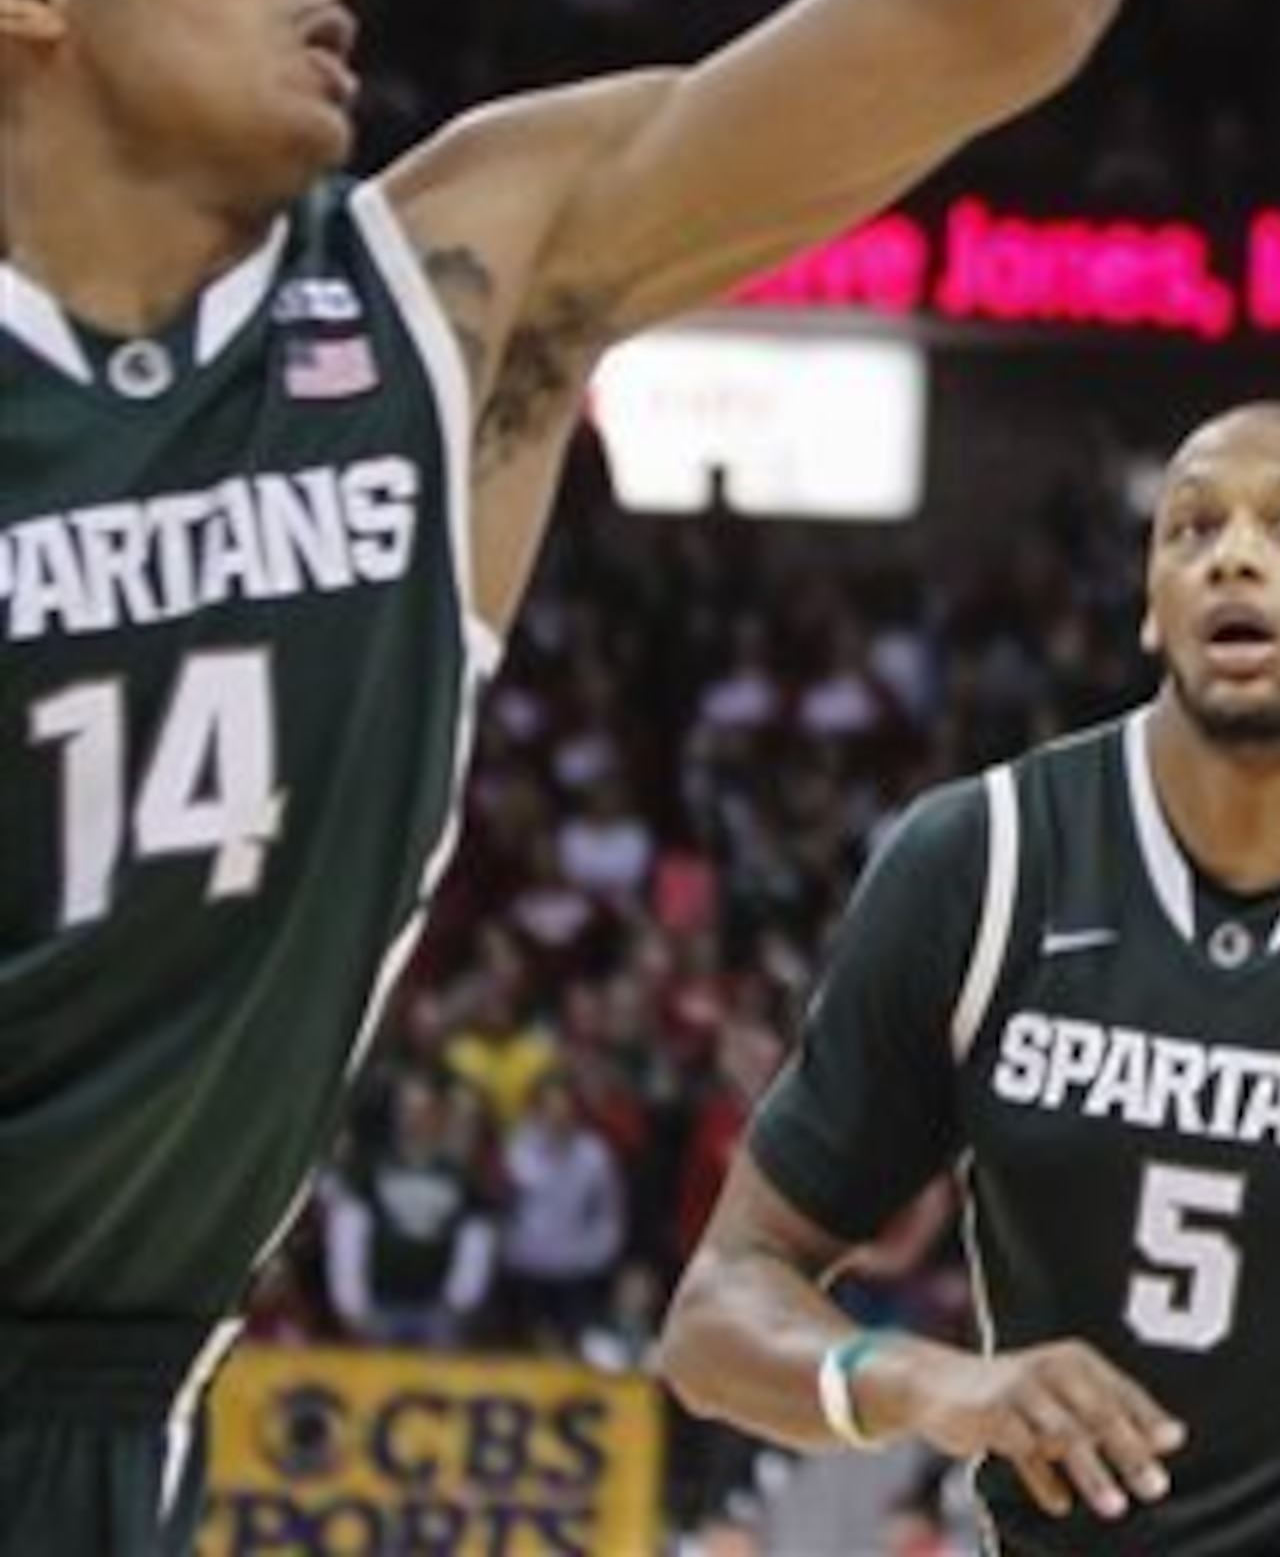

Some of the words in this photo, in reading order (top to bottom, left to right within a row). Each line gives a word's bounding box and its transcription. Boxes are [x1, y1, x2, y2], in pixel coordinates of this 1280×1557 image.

[0, 454, 418, 640] ARTANS
[28, 643, 288, 930] 14
[1122, 1158, 1248, 1355] 5
[225, 1491, 593, 1557] PORTS
[367, 1391, 611, 1489] CBS
